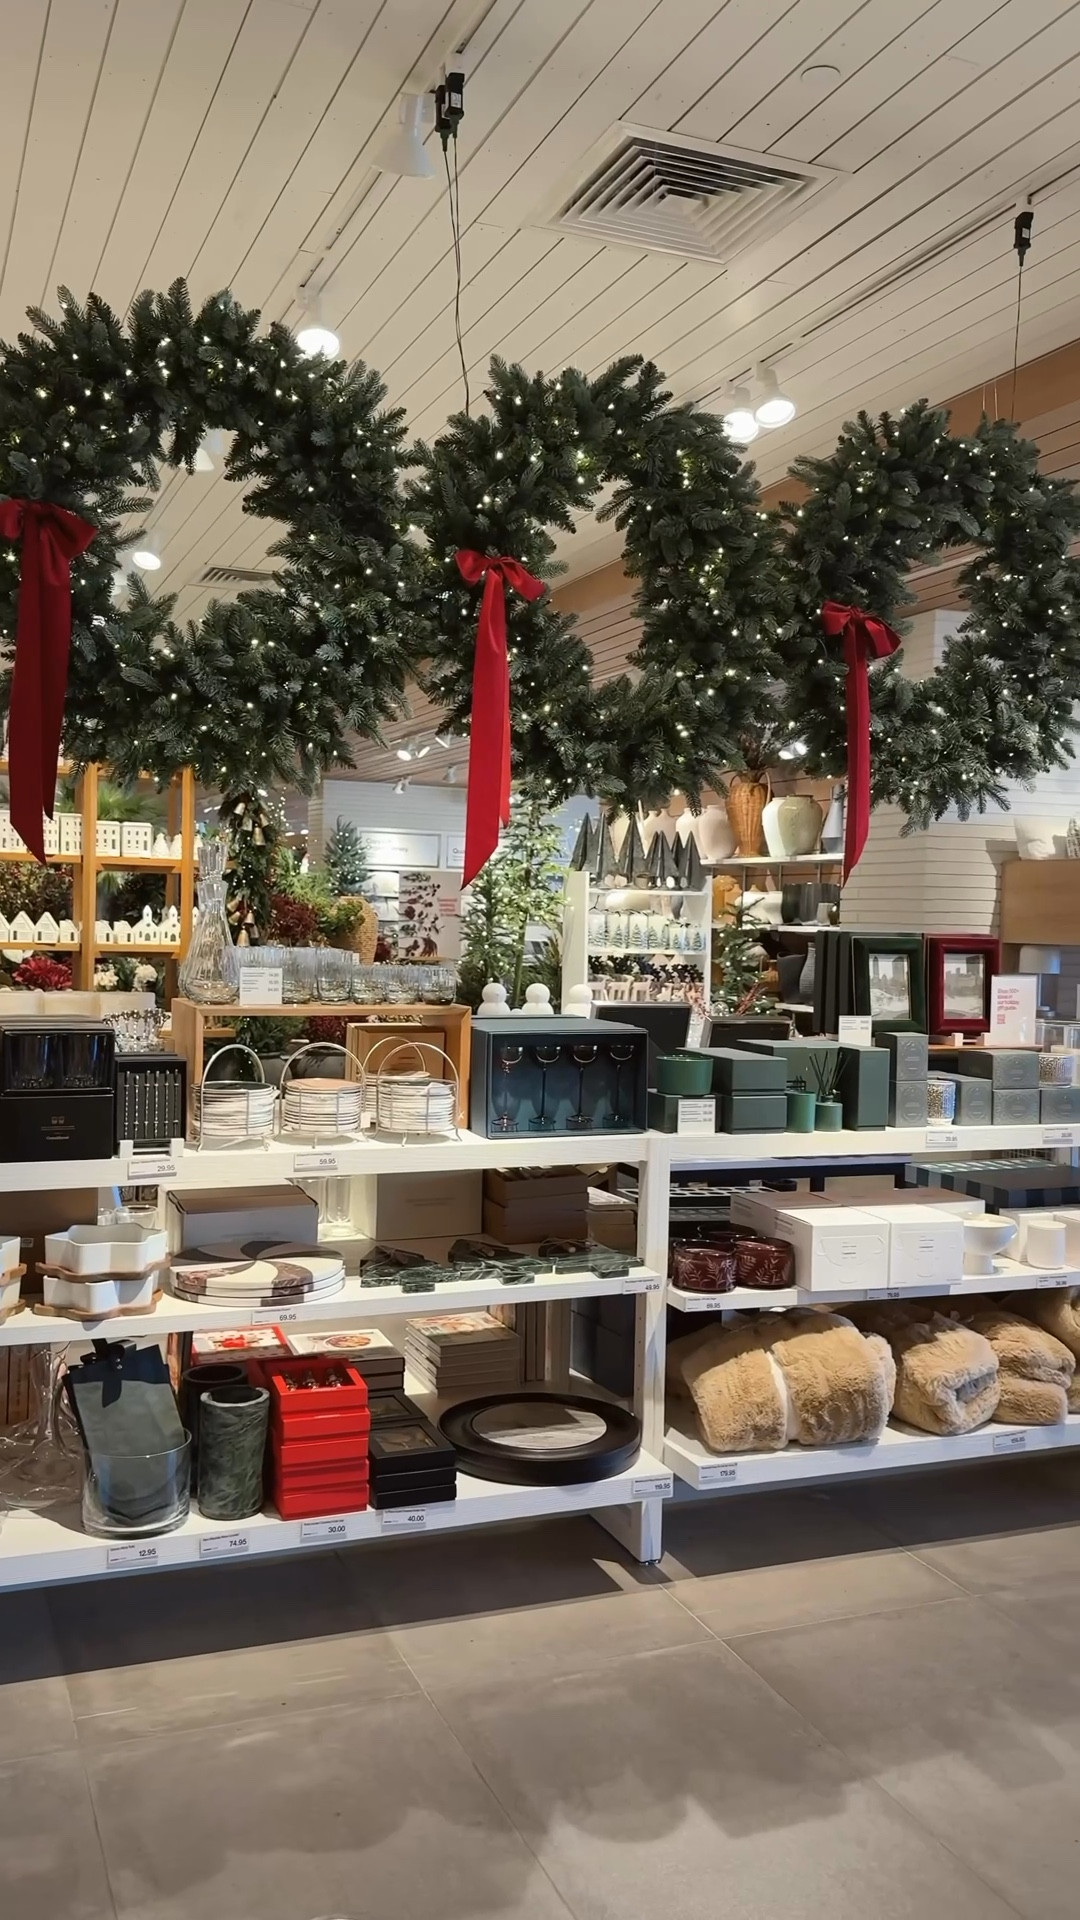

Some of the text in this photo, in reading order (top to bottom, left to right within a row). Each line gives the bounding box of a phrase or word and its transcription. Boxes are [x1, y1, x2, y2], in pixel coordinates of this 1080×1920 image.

[319, 1157, 336, 1165] 59.95
[157, 1164, 176, 1172] 29.95
[279, 1313, 297, 1321] 69.95
[327, 1525, 346, 1533] 30.00
[228, 1538, 247, 1547] 74.95
[138, 1547, 157, 1557] 12.95
